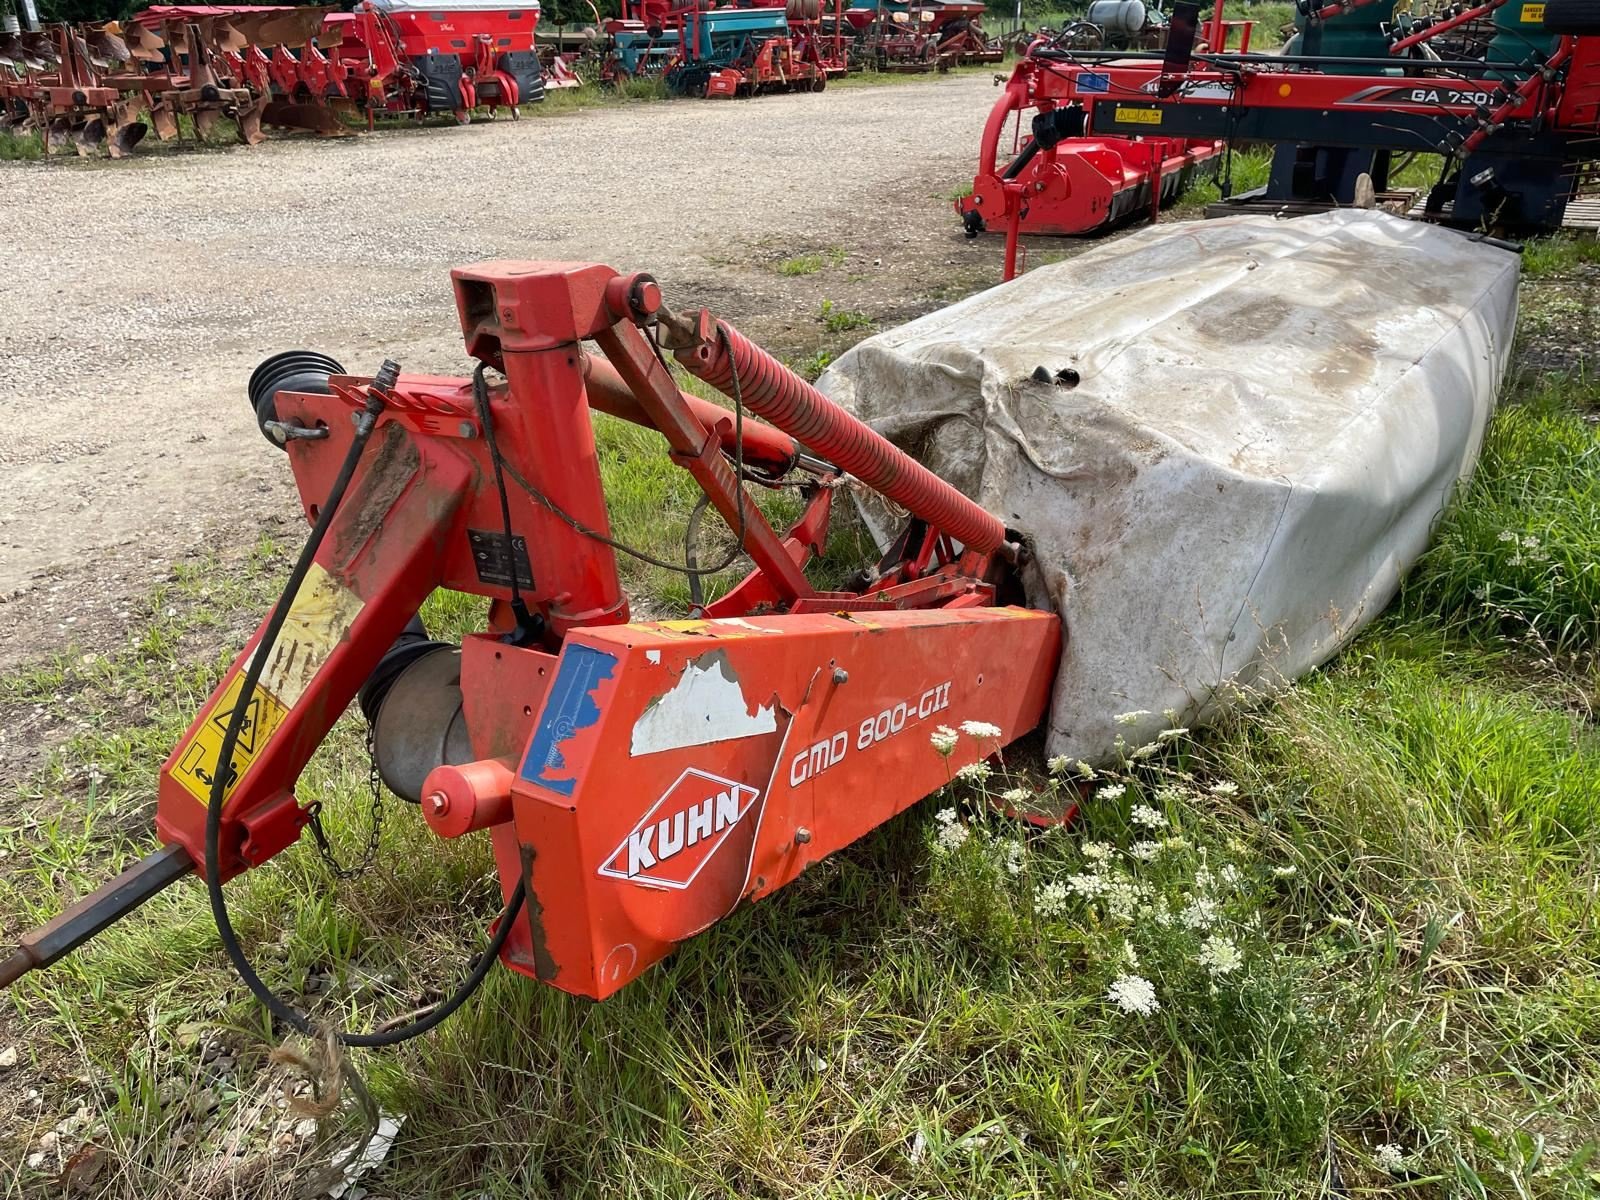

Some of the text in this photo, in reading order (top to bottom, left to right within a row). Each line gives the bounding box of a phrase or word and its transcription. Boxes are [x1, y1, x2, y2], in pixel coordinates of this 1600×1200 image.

[1411, 89, 1440, 103] GA
[789, 680, 952, 788] GMD 800-GII
[627, 783, 740, 878] KUHN
